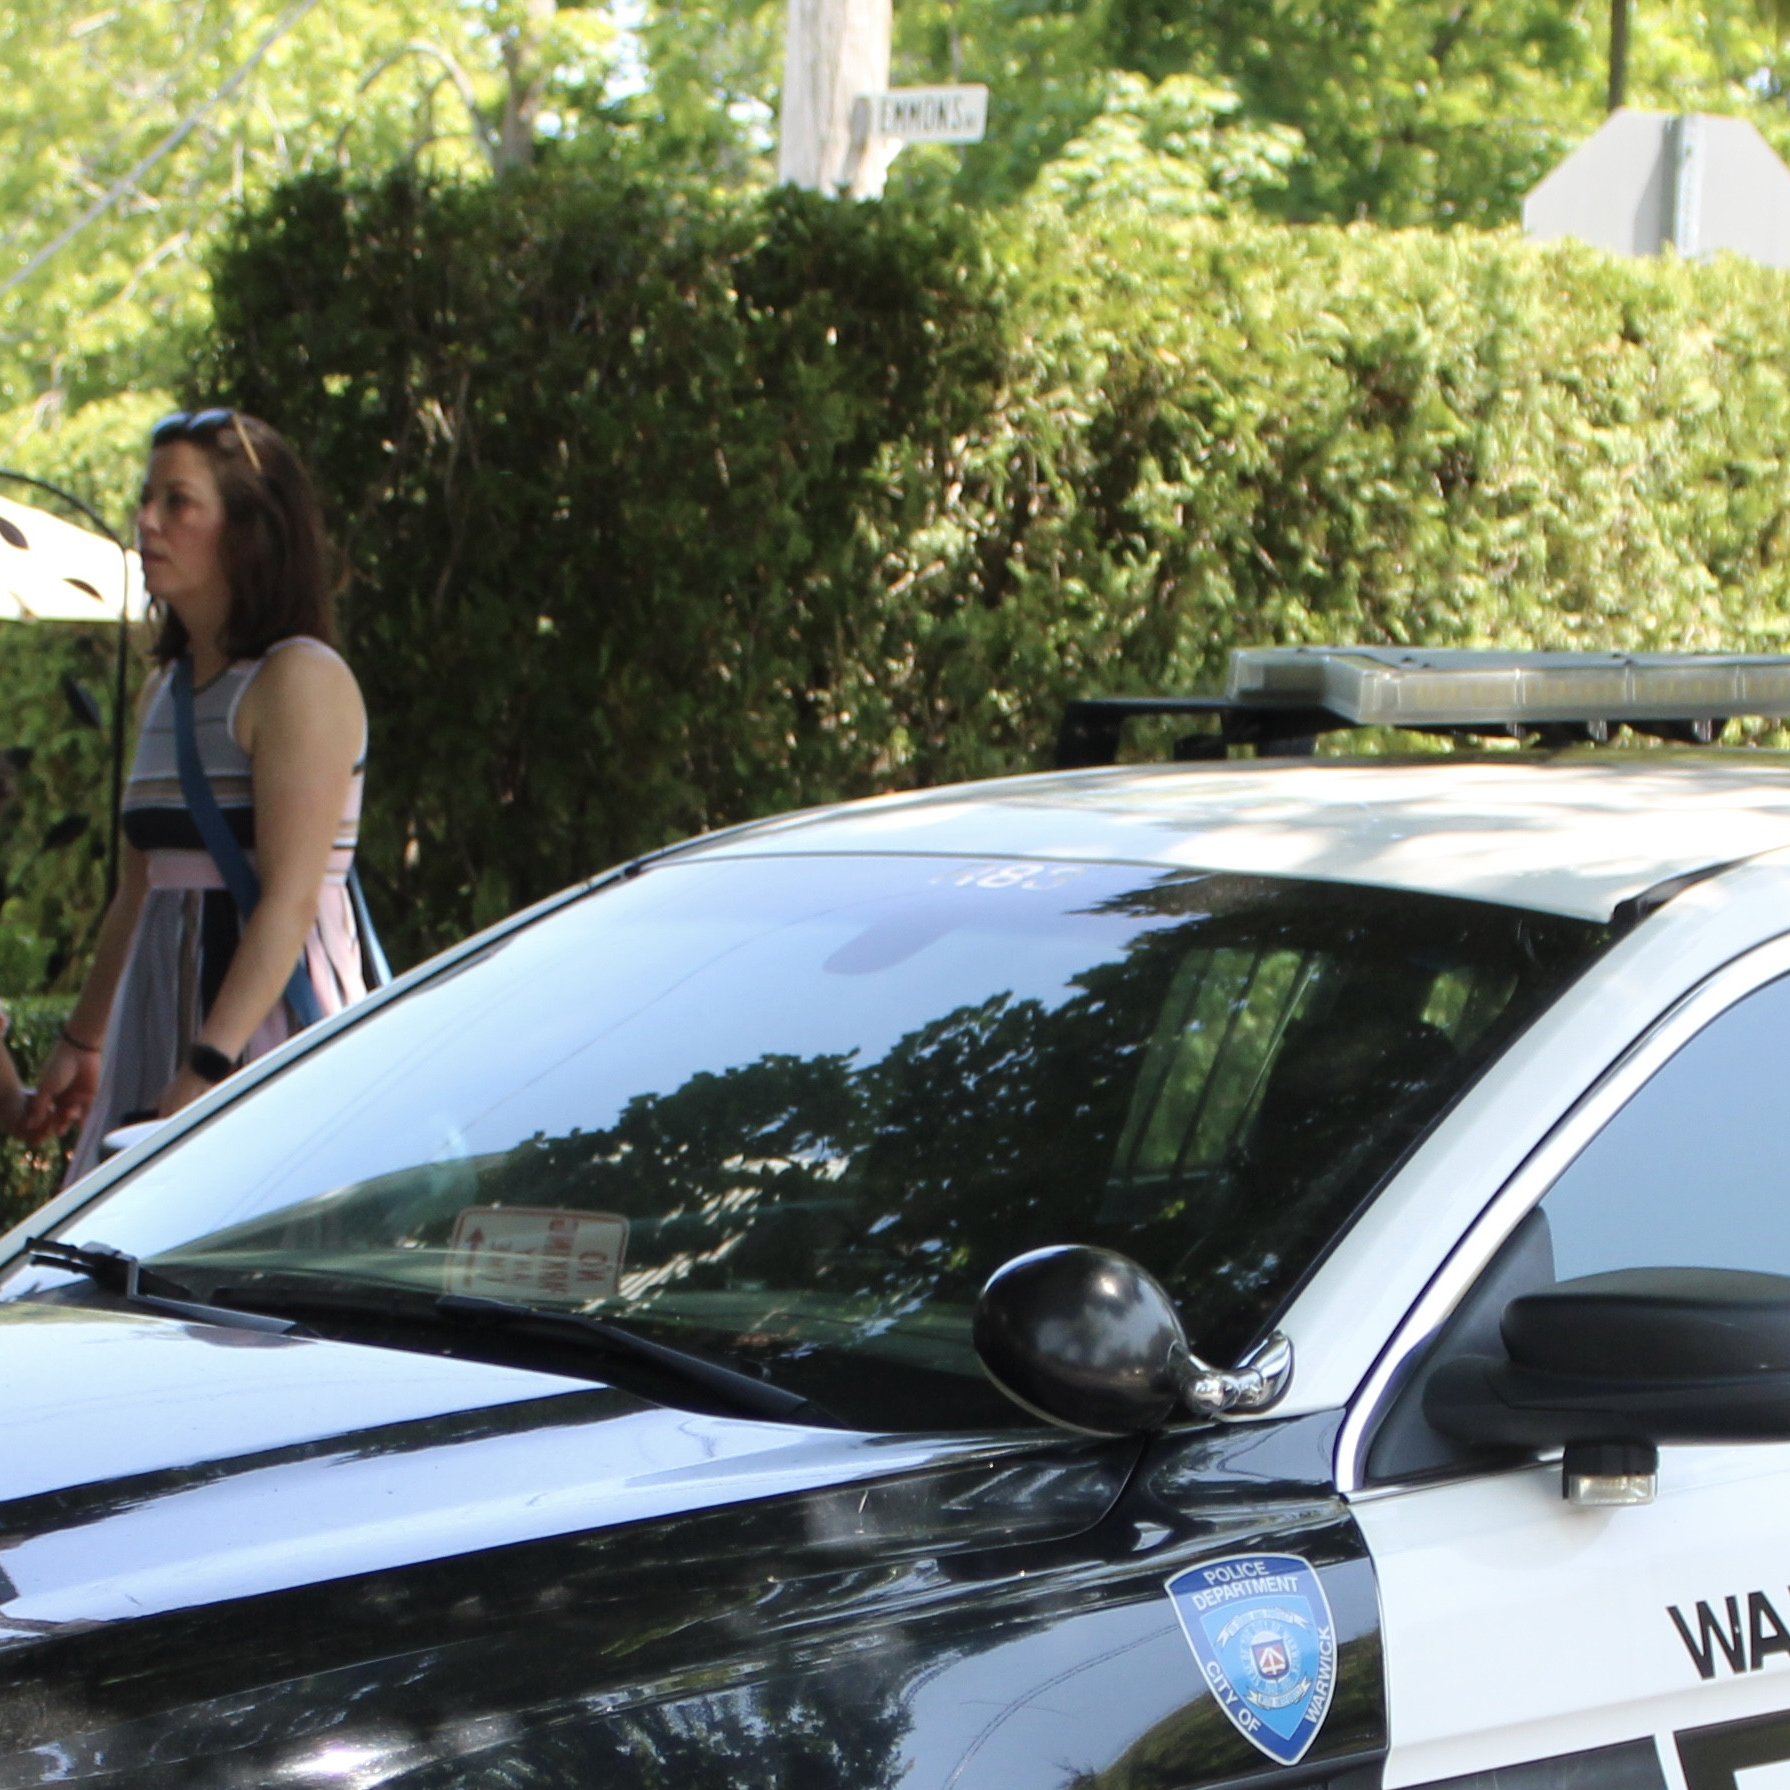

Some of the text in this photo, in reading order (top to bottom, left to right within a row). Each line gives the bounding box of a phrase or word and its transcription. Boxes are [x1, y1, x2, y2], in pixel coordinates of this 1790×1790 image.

[881, 95, 961, 132] EMMONS
[1203, 1561, 1271, 1585] POLICE
[1192, 1575, 1299, 1611] DEPARTMENT
[1206, 1661, 1238, 1704] CITY
[1238, 1708, 1262, 1733] OF
[1305, 1625, 1331, 1724] WARWICK
